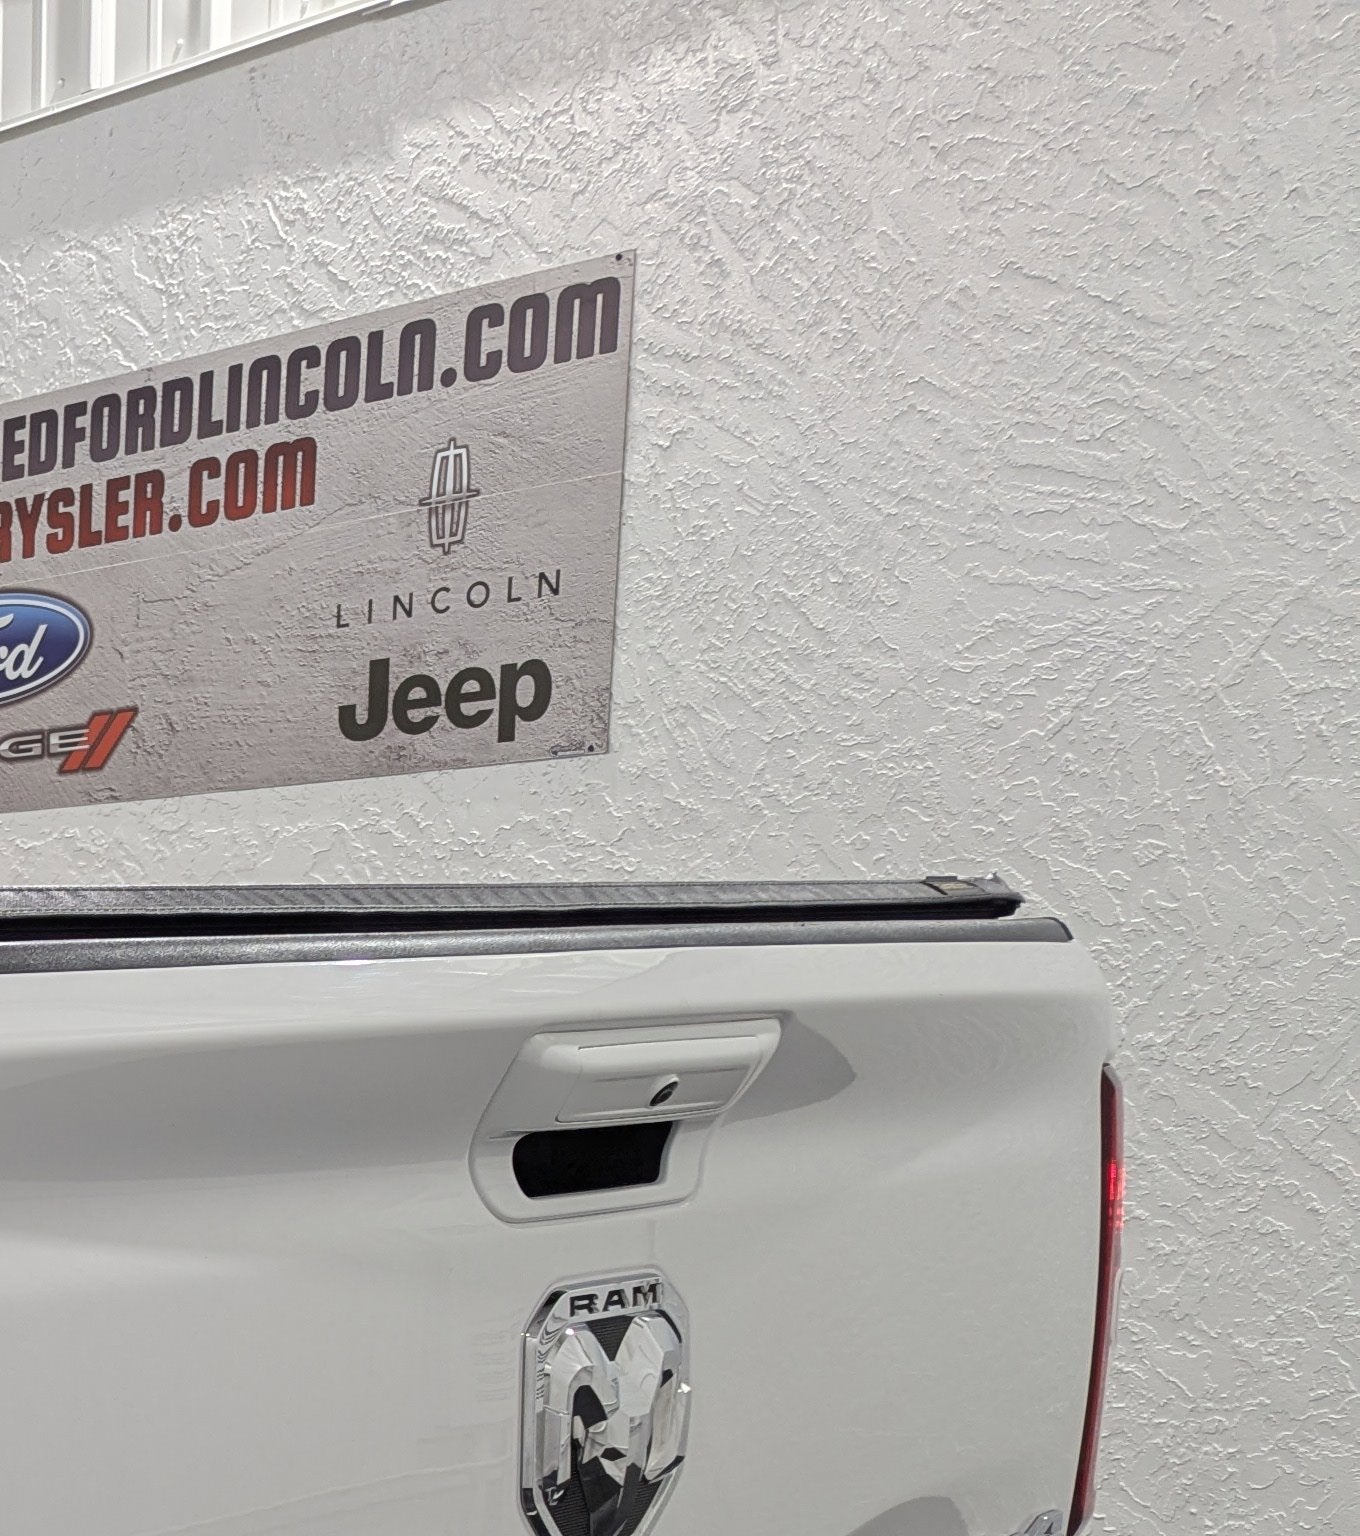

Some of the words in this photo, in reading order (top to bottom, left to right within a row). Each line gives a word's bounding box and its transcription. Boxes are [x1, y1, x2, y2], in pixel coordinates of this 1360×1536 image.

[335, 569, 562, 629] LINCOLN
[338, 657, 553, 743] Jeep
[570, 1282, 662, 1318] RAM
